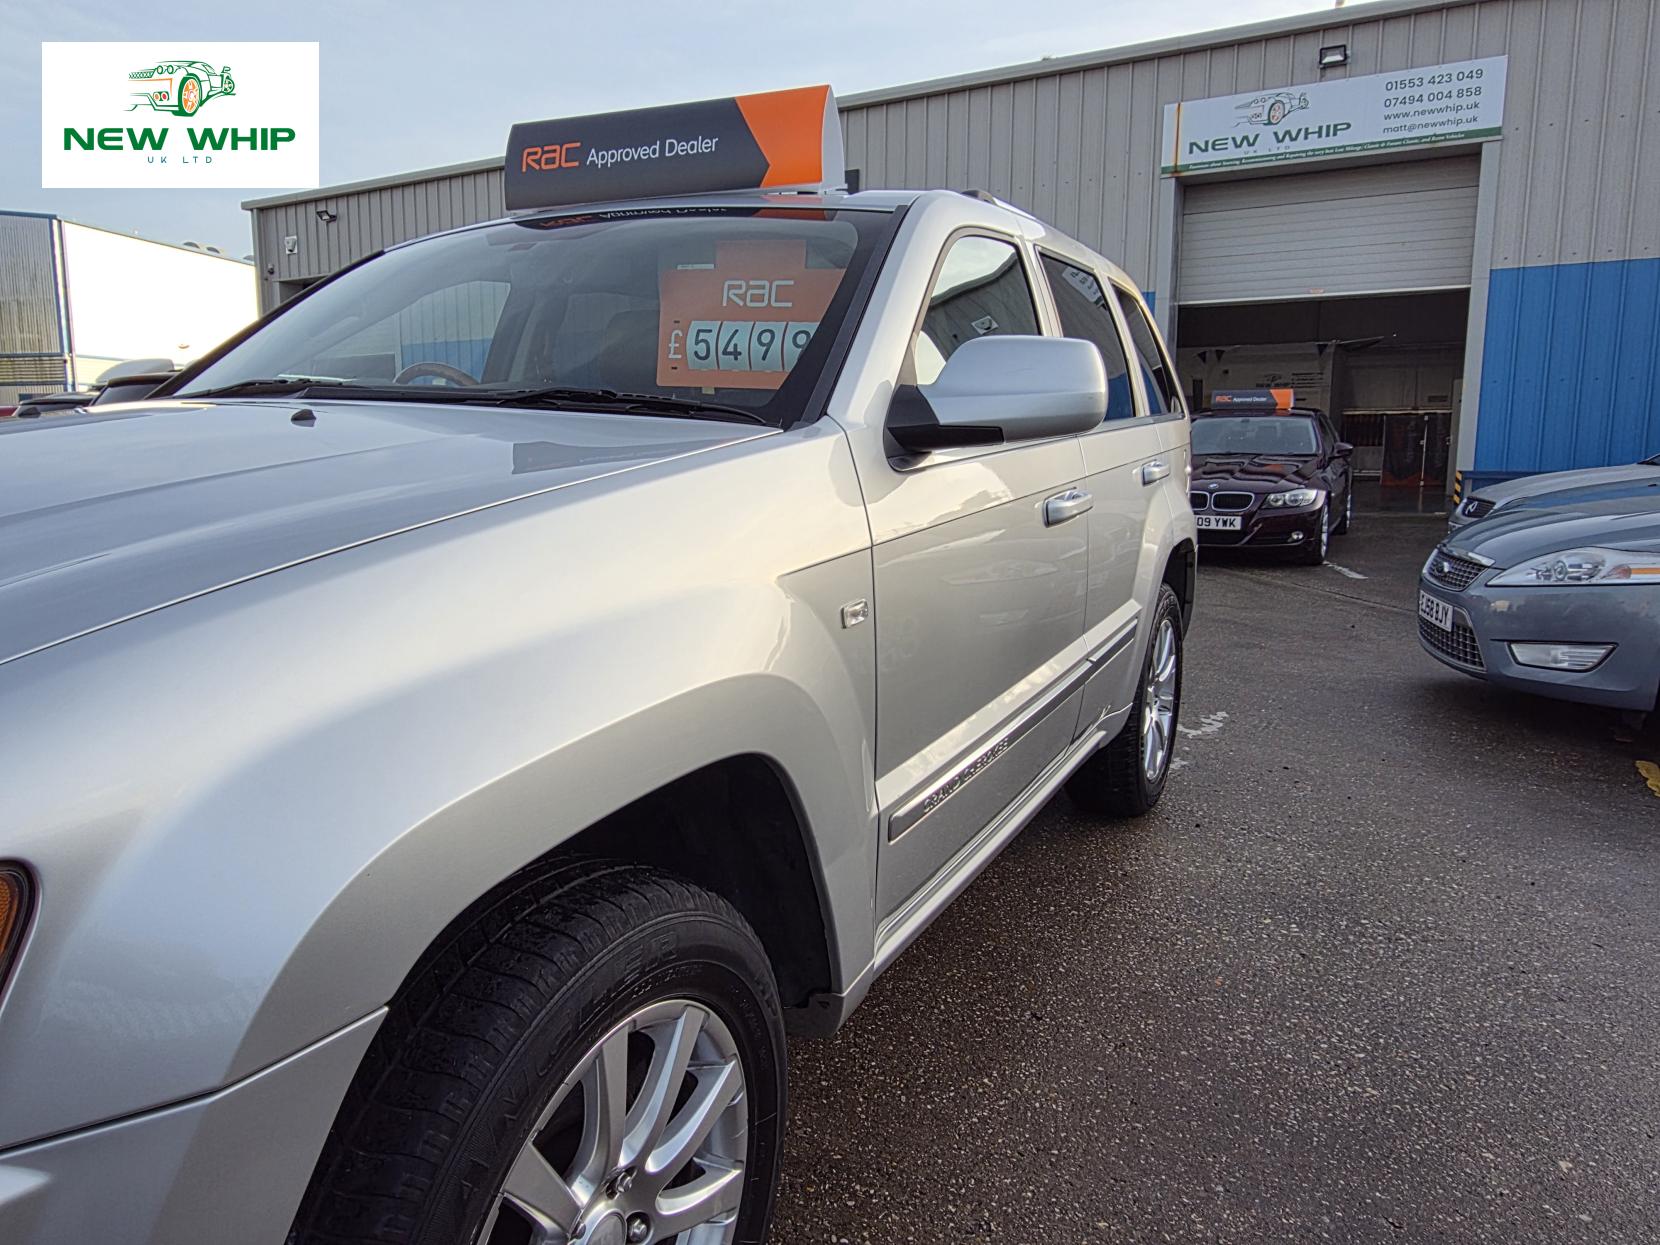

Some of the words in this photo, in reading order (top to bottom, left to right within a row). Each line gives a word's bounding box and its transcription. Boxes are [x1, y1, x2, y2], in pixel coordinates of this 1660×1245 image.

[1385, 78, 1424, 91] 01553
[1427, 73, 1453, 86] 423
[1456, 69, 1483, 82] 049
[1384, 94, 1424, 108] 07494
[1427, 90, 1453, 103] 004
[1456, 86, 1482, 99] 858
[1383, 101, 1480, 121] www.newwhip.uk
[1382, 115, 1478, 134] matt@newwhip.uk
[1188, 133, 1260, 155] NEW
[1273, 121, 1352, 144] WHIP
[586, 141, 660, 169] Approved
[665, 135, 719, 158] Dealer
[1214, 517, 1236, 528] YWK
